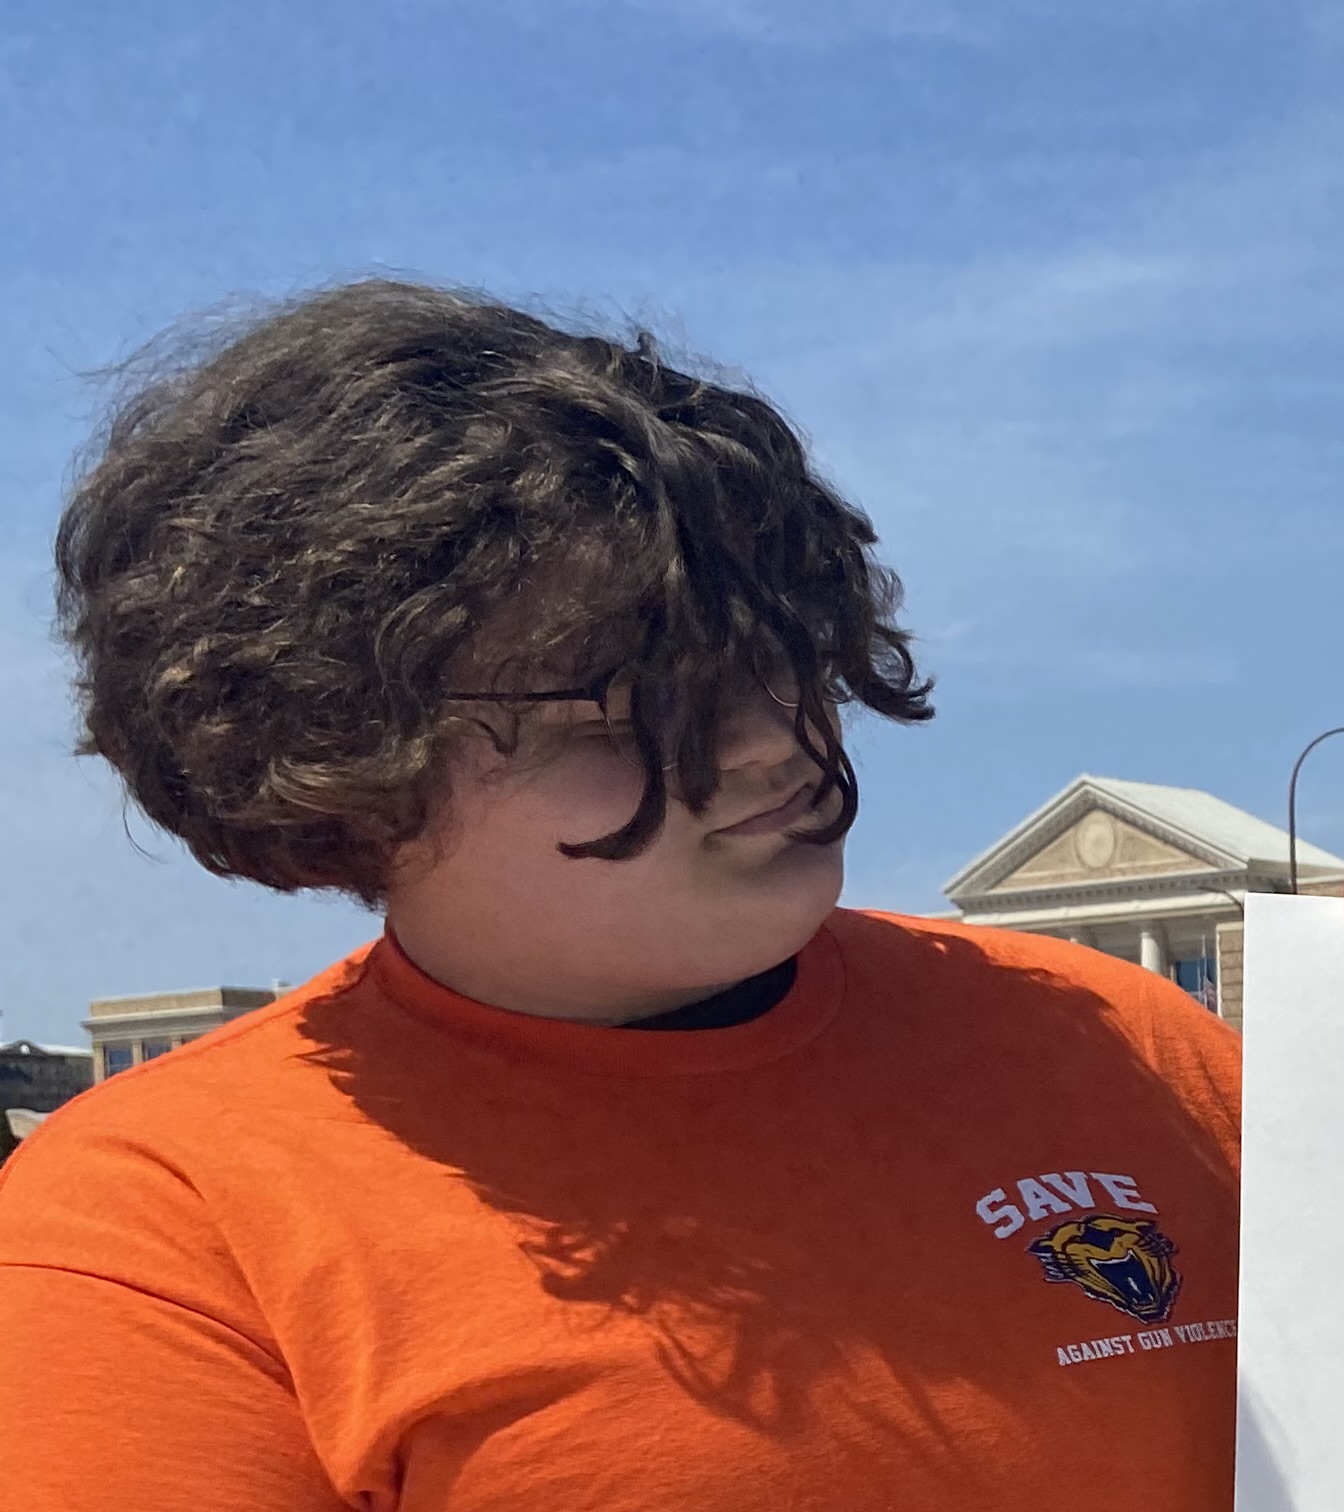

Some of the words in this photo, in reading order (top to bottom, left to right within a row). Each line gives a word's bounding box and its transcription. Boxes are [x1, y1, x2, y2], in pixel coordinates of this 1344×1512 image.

[976, 1171, 1158, 1239] SAVE
[1056, 1335, 1135, 1366] AGAINST
[1137, 1328, 1173, 1350] GUN
[1175, 1319, 1237, 1343] VIOLENC
